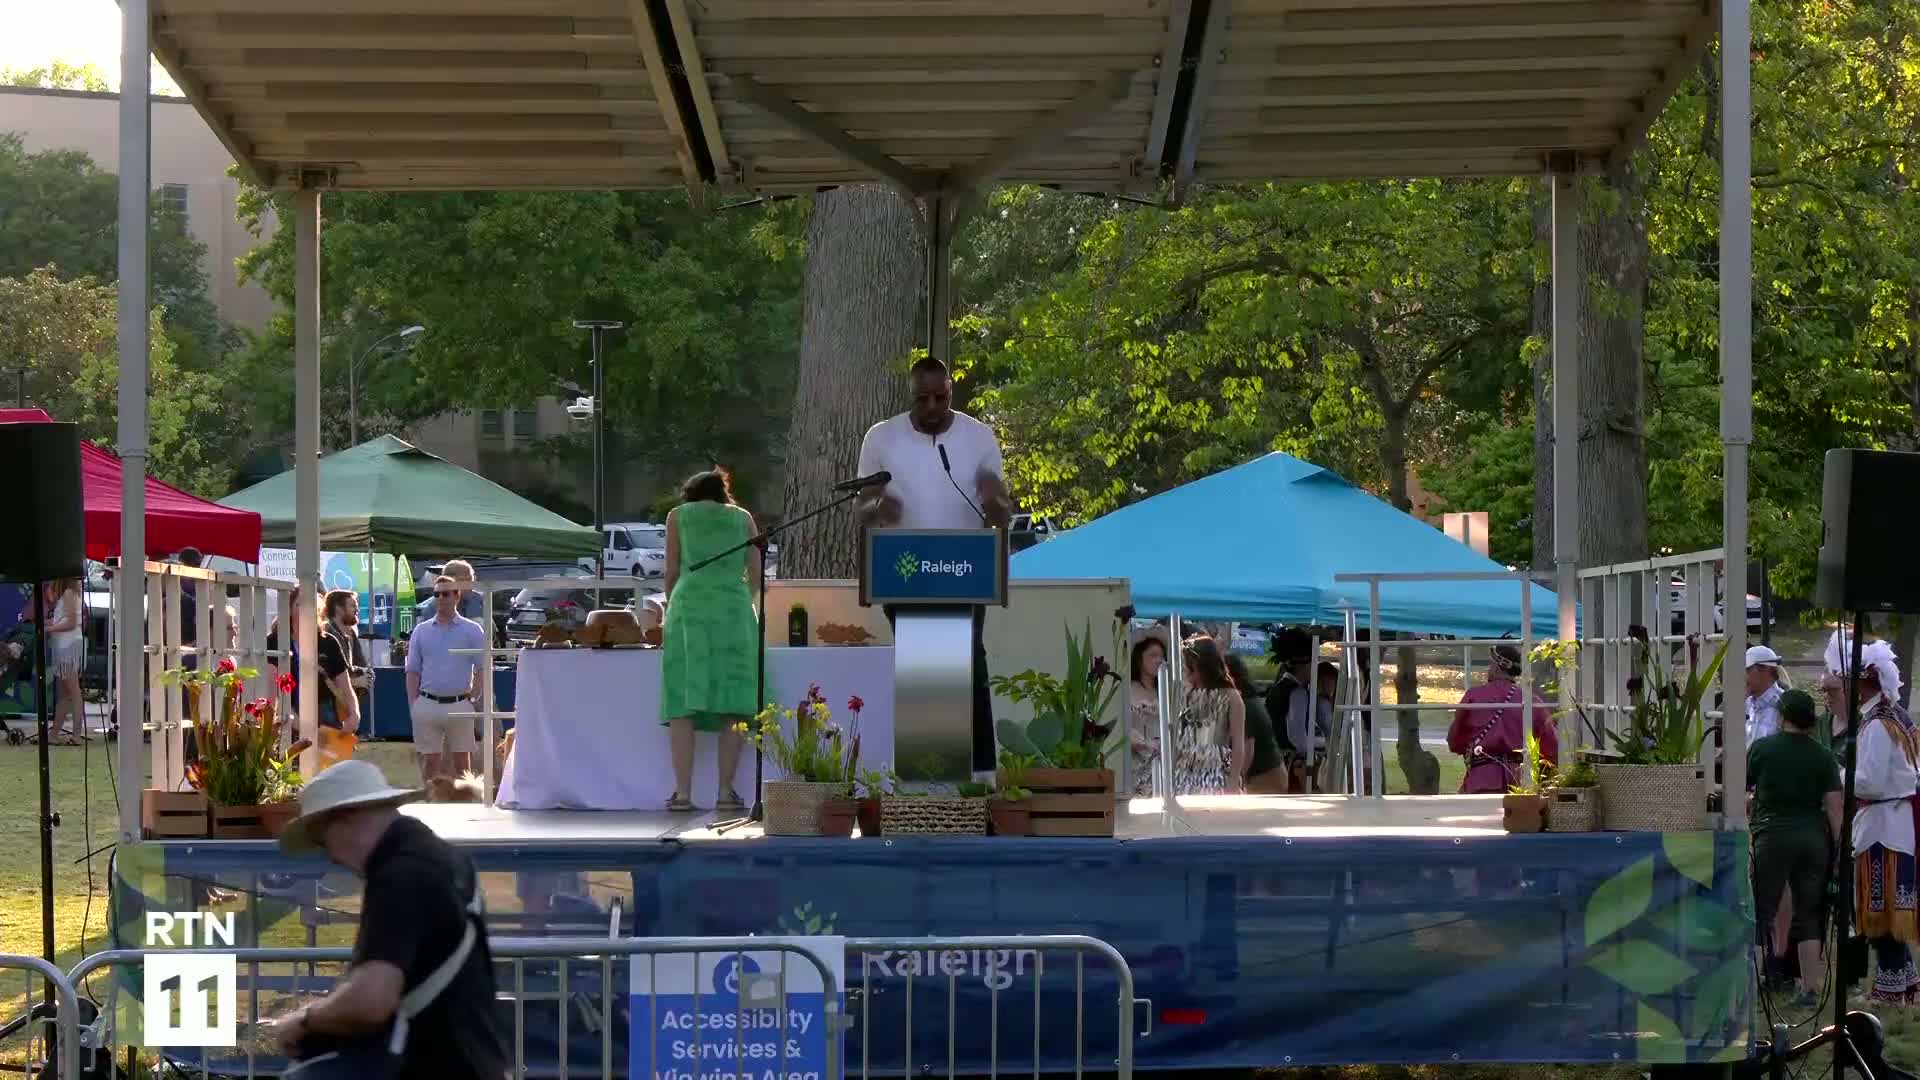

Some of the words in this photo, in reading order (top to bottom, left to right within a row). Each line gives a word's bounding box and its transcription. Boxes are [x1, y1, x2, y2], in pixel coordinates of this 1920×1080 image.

[921, 560, 972, 576] Raleigh
[672, 1038, 777, 1059] Services
[785, 1039, 801, 1058] &
